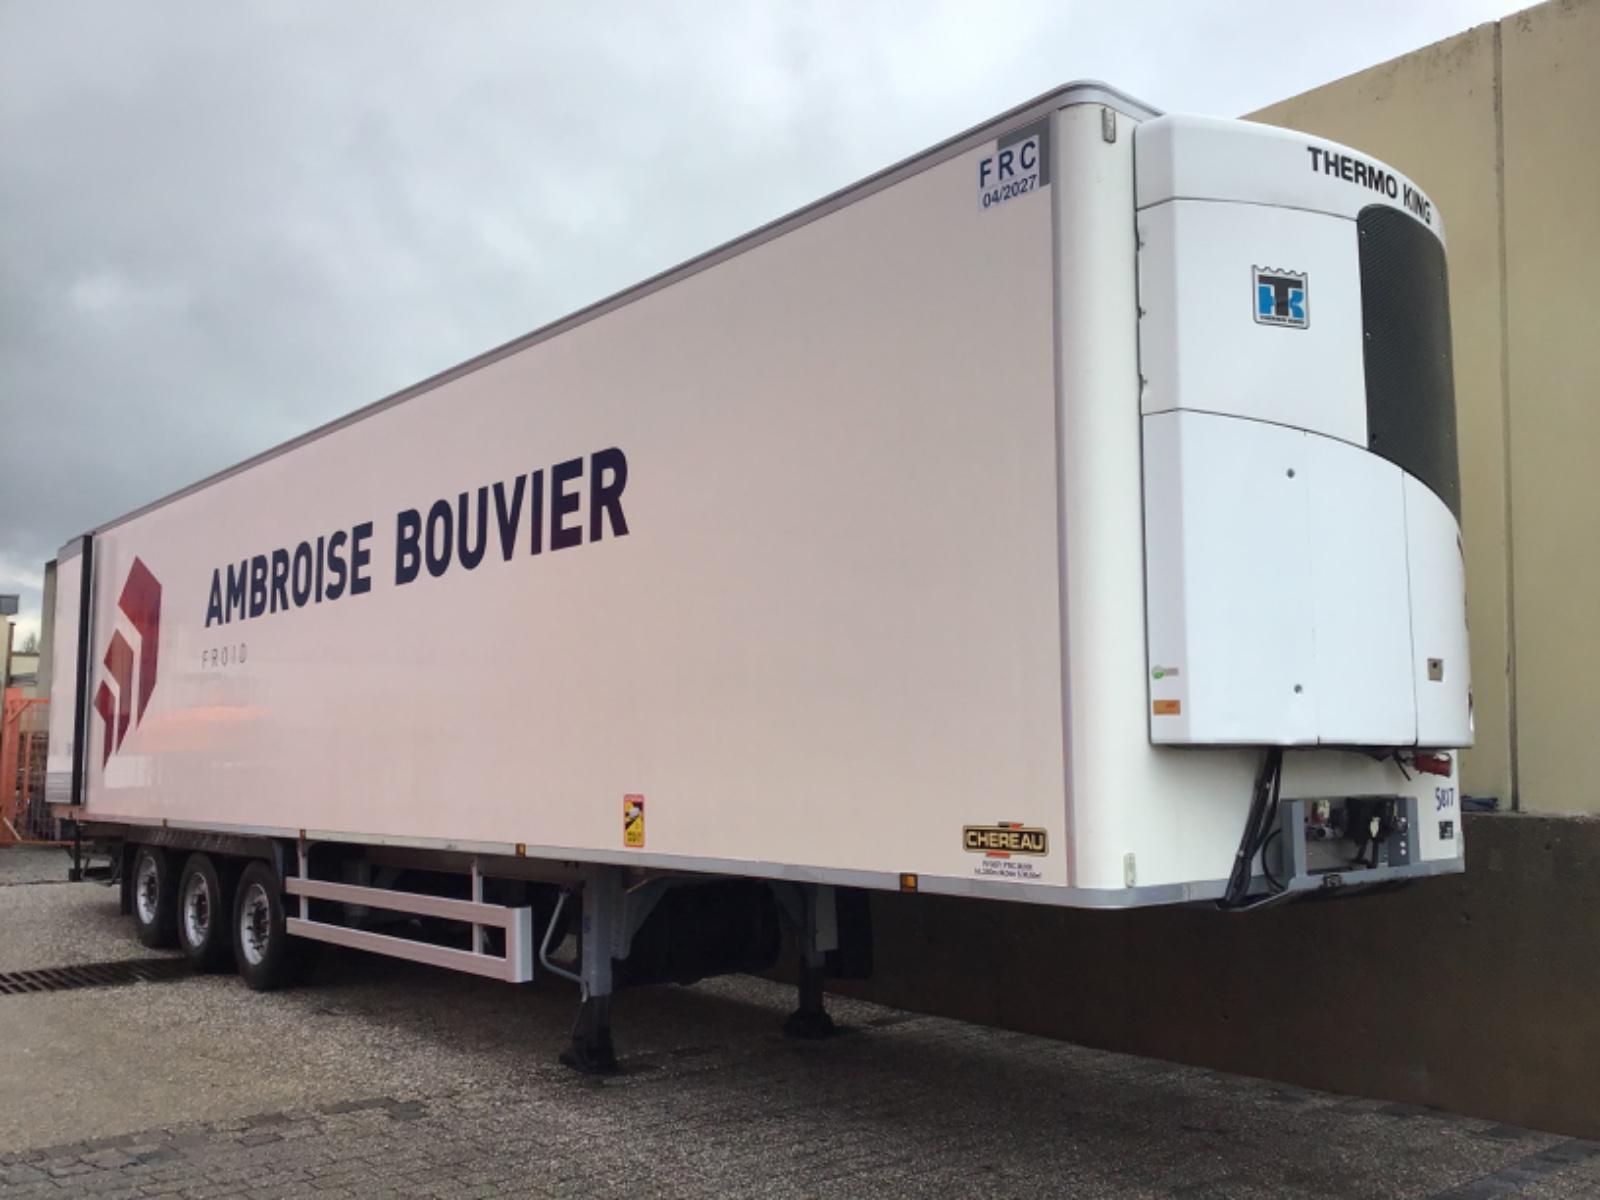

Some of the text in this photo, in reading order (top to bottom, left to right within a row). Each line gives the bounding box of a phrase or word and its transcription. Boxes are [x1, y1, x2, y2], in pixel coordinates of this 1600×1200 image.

[980, 141, 1036, 188] FRC
[983, 174, 1037, 208] 04/2027
[1307, 146, 1431, 225] THERMO KING
[205, 446, 630, 628] AMBROISE BOUVIER
[201, 643, 248, 669] FROID
[966, 830, 1044, 849] CHEREAU
